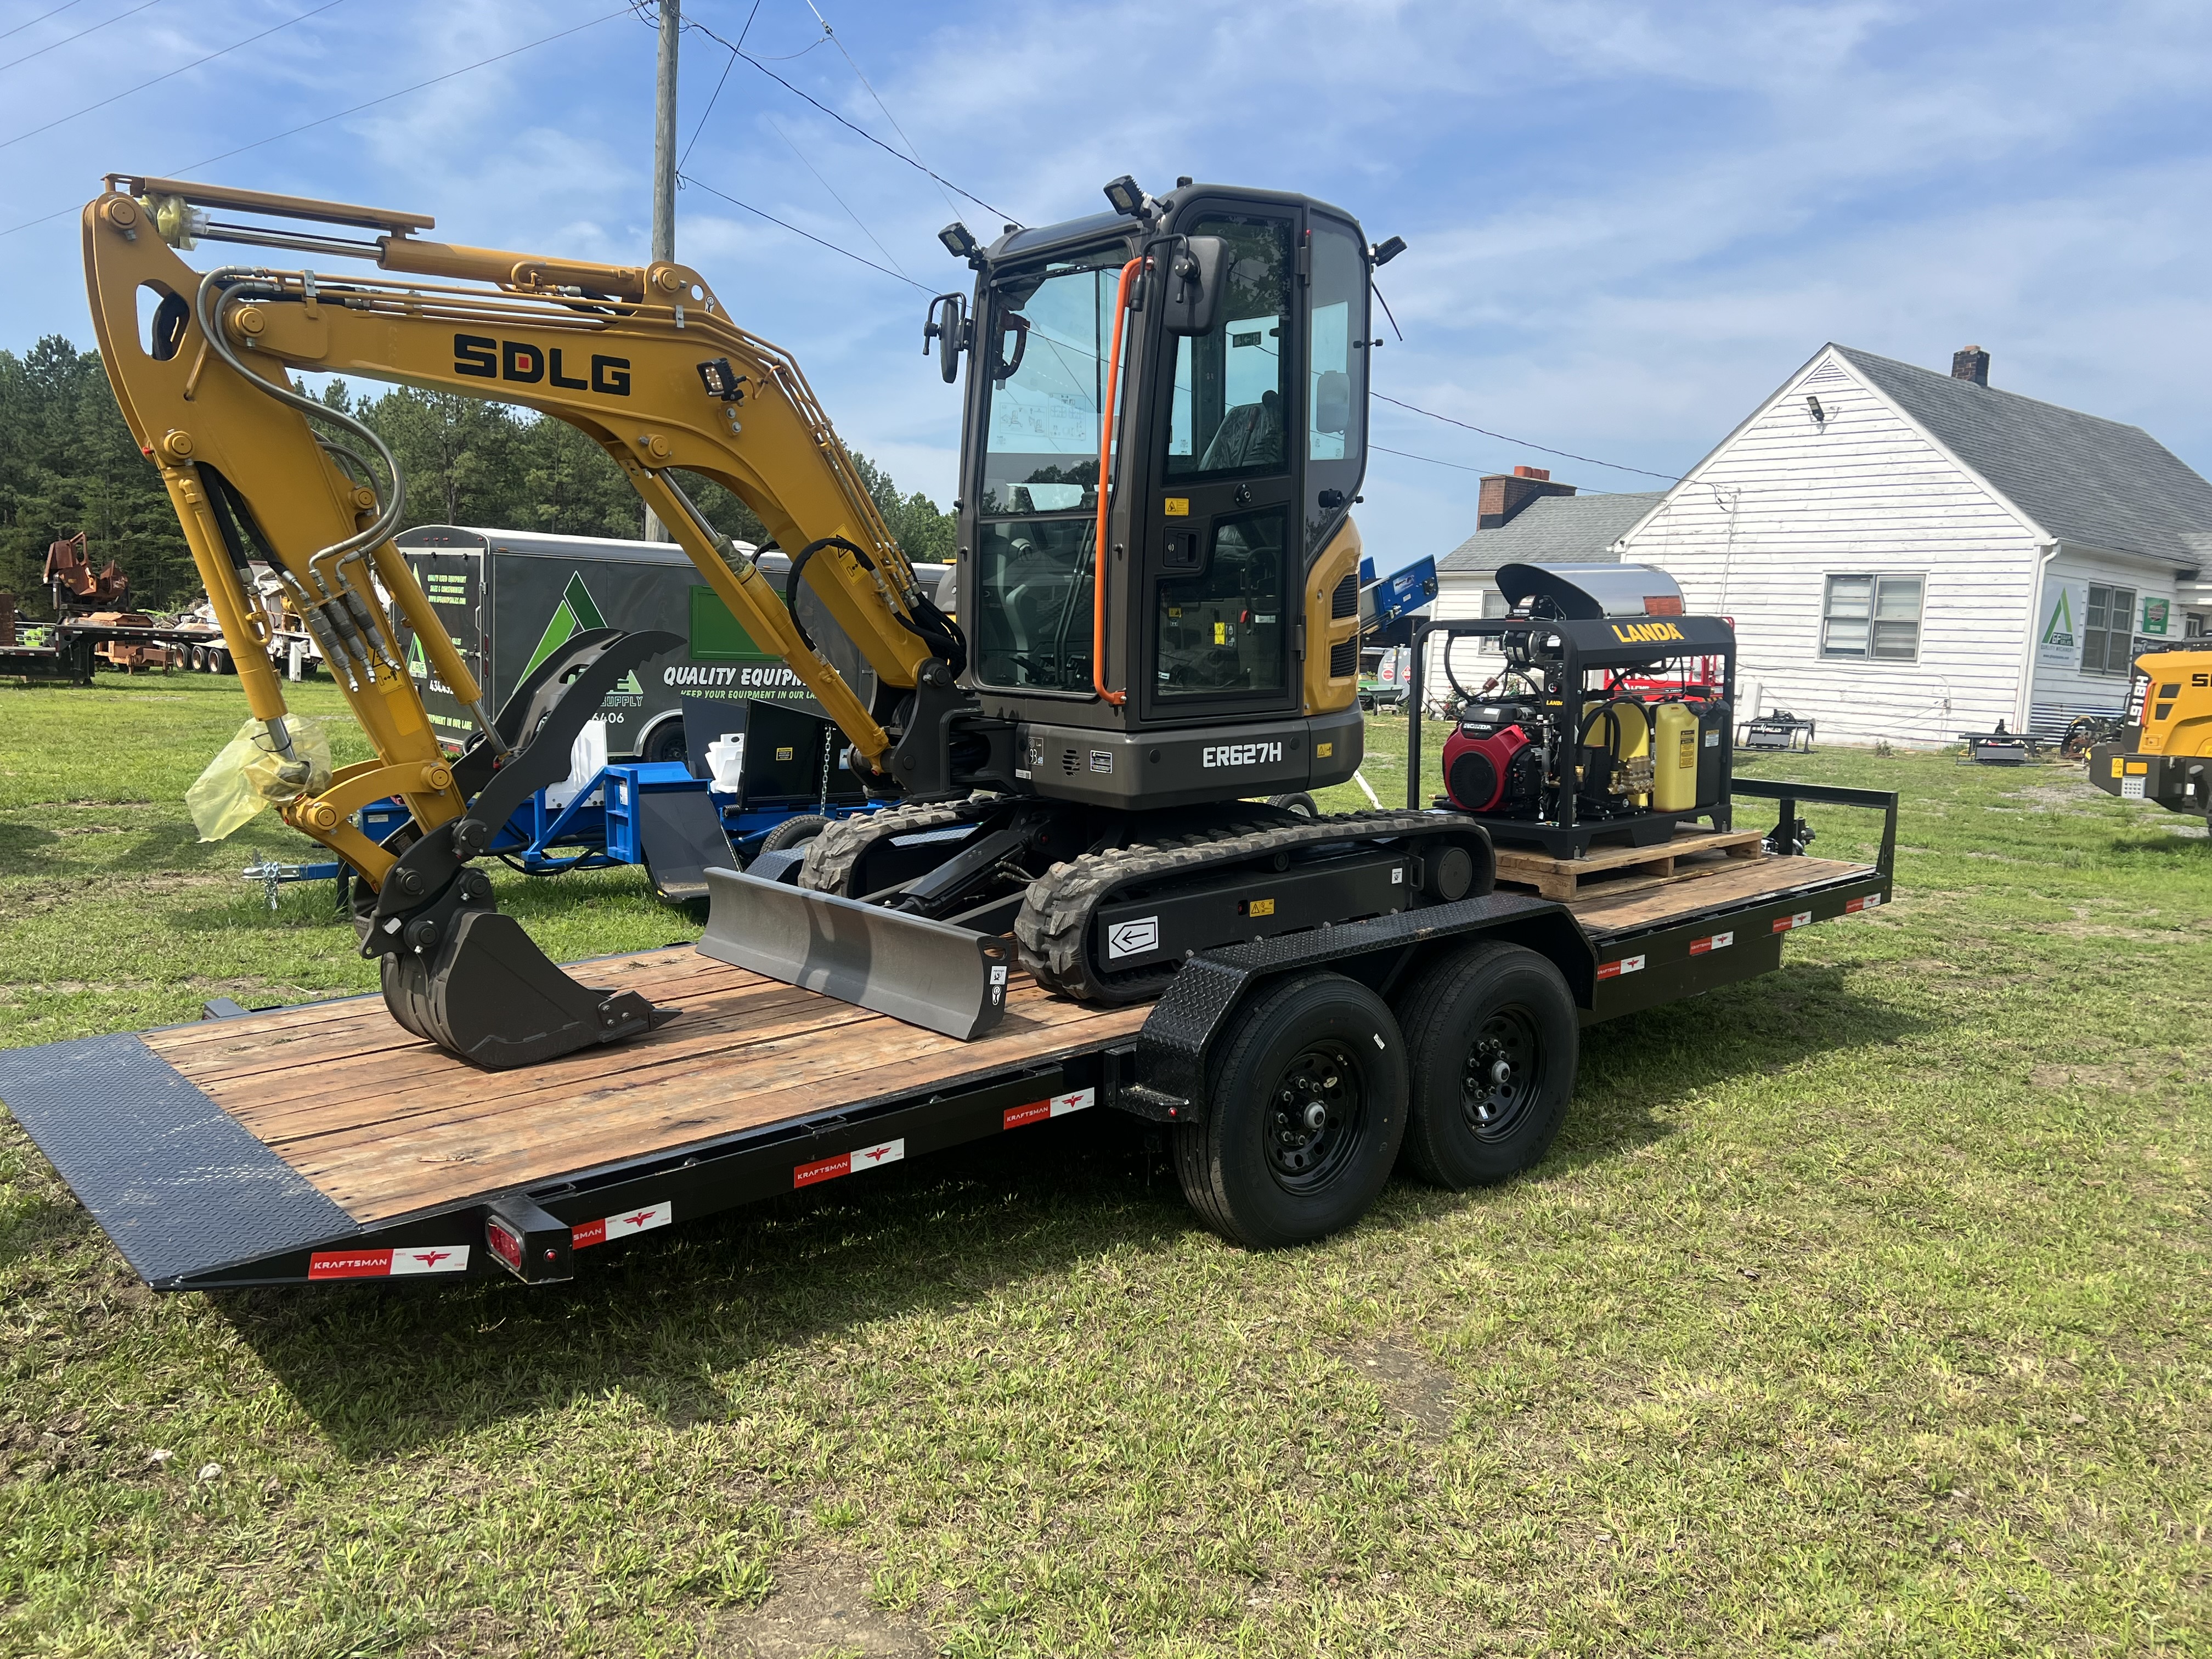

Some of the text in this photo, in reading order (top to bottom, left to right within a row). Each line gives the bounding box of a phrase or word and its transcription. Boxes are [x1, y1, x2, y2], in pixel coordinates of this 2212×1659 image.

[454, 334, 630, 396] SDLG
[663, 667, 840, 687] QUALITY EQUIPM
[704, 690, 726, 699] YOUR
[728, 690, 776, 699] EQUIPMENT
[777, 691, 787, 699] IN
[788, 691, 804, 699] OUR
[806, 691, 817, 699] LA
[461, 720, 472, 731] LANE
[1203, 742, 1282, 768] ER627H
[1007, 1106, 1048, 1122] KRAFTSMAN
[798, 1161, 848, 1180] KRAFTSMAN
[314, 1259, 387, 1269] KRAFTSMAN
